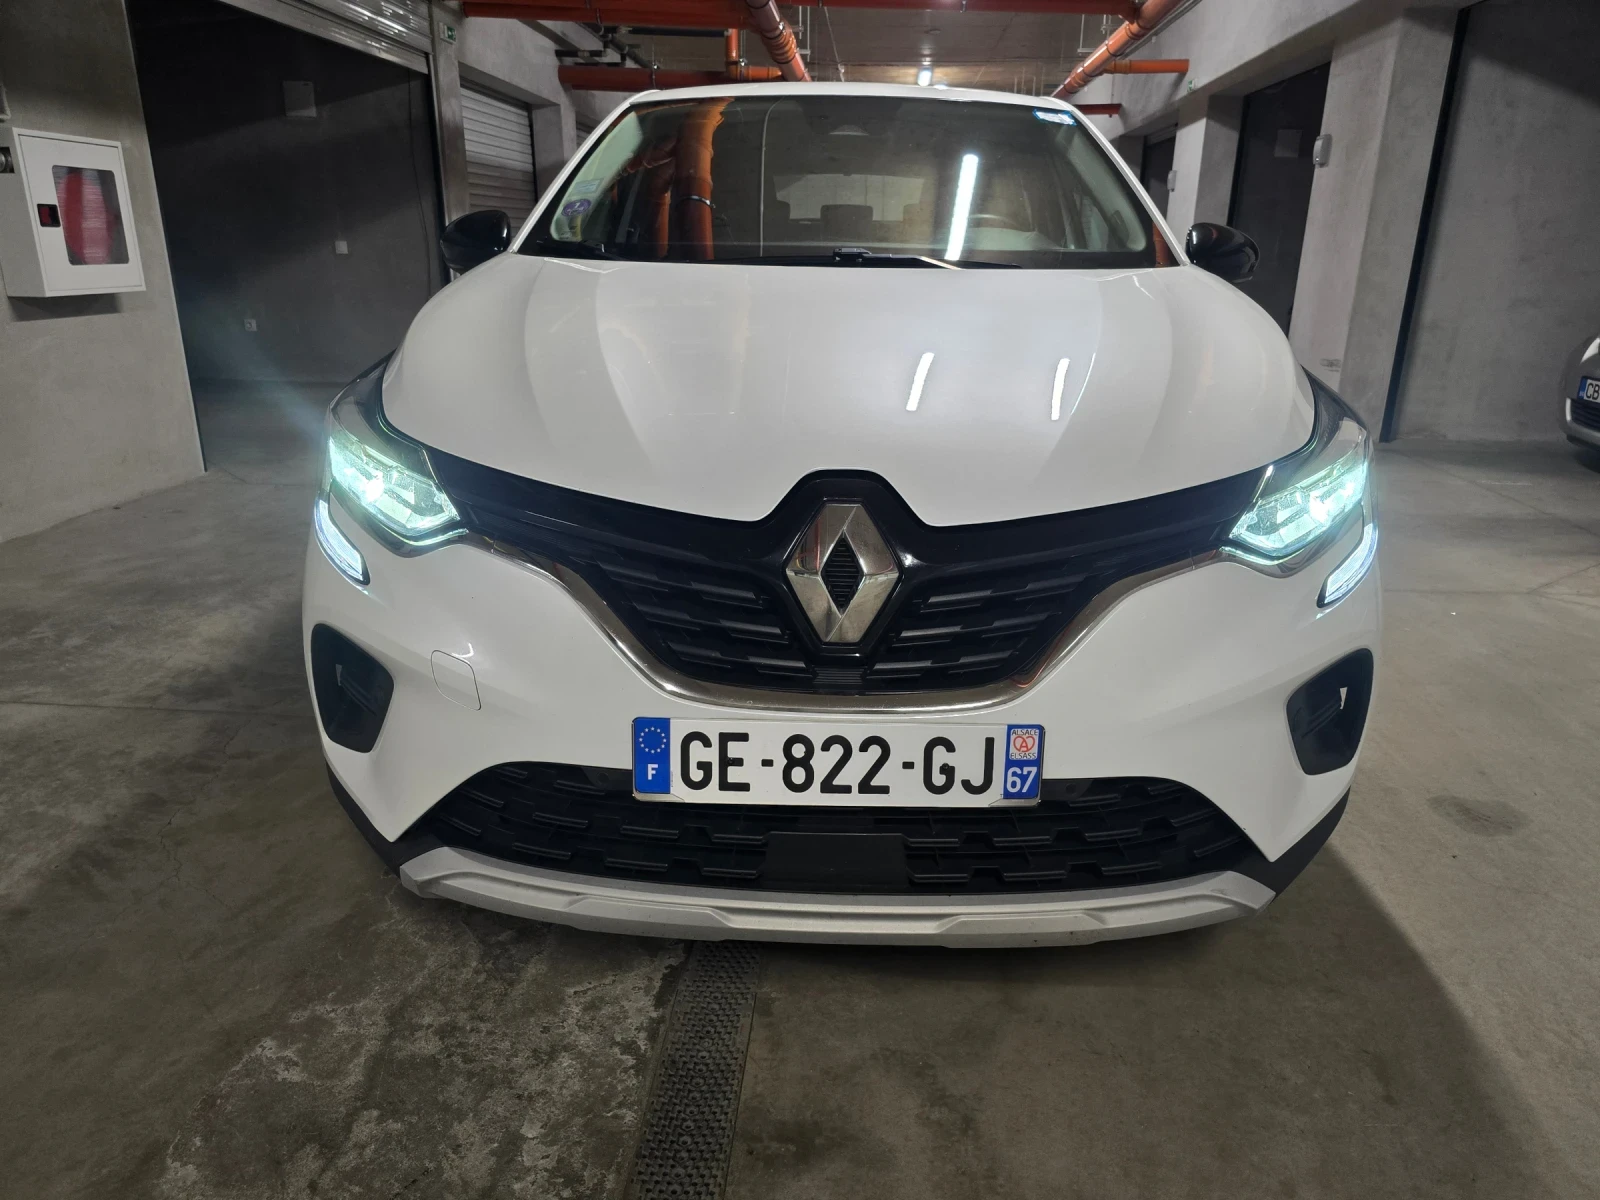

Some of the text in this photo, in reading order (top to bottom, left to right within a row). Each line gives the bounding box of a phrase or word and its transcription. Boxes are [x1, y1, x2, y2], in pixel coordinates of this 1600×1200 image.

[647, 763, 659, 780] F
[680, 731, 996, 797] GE-822-GJ
[1006, 766, 1038, 793] 67
